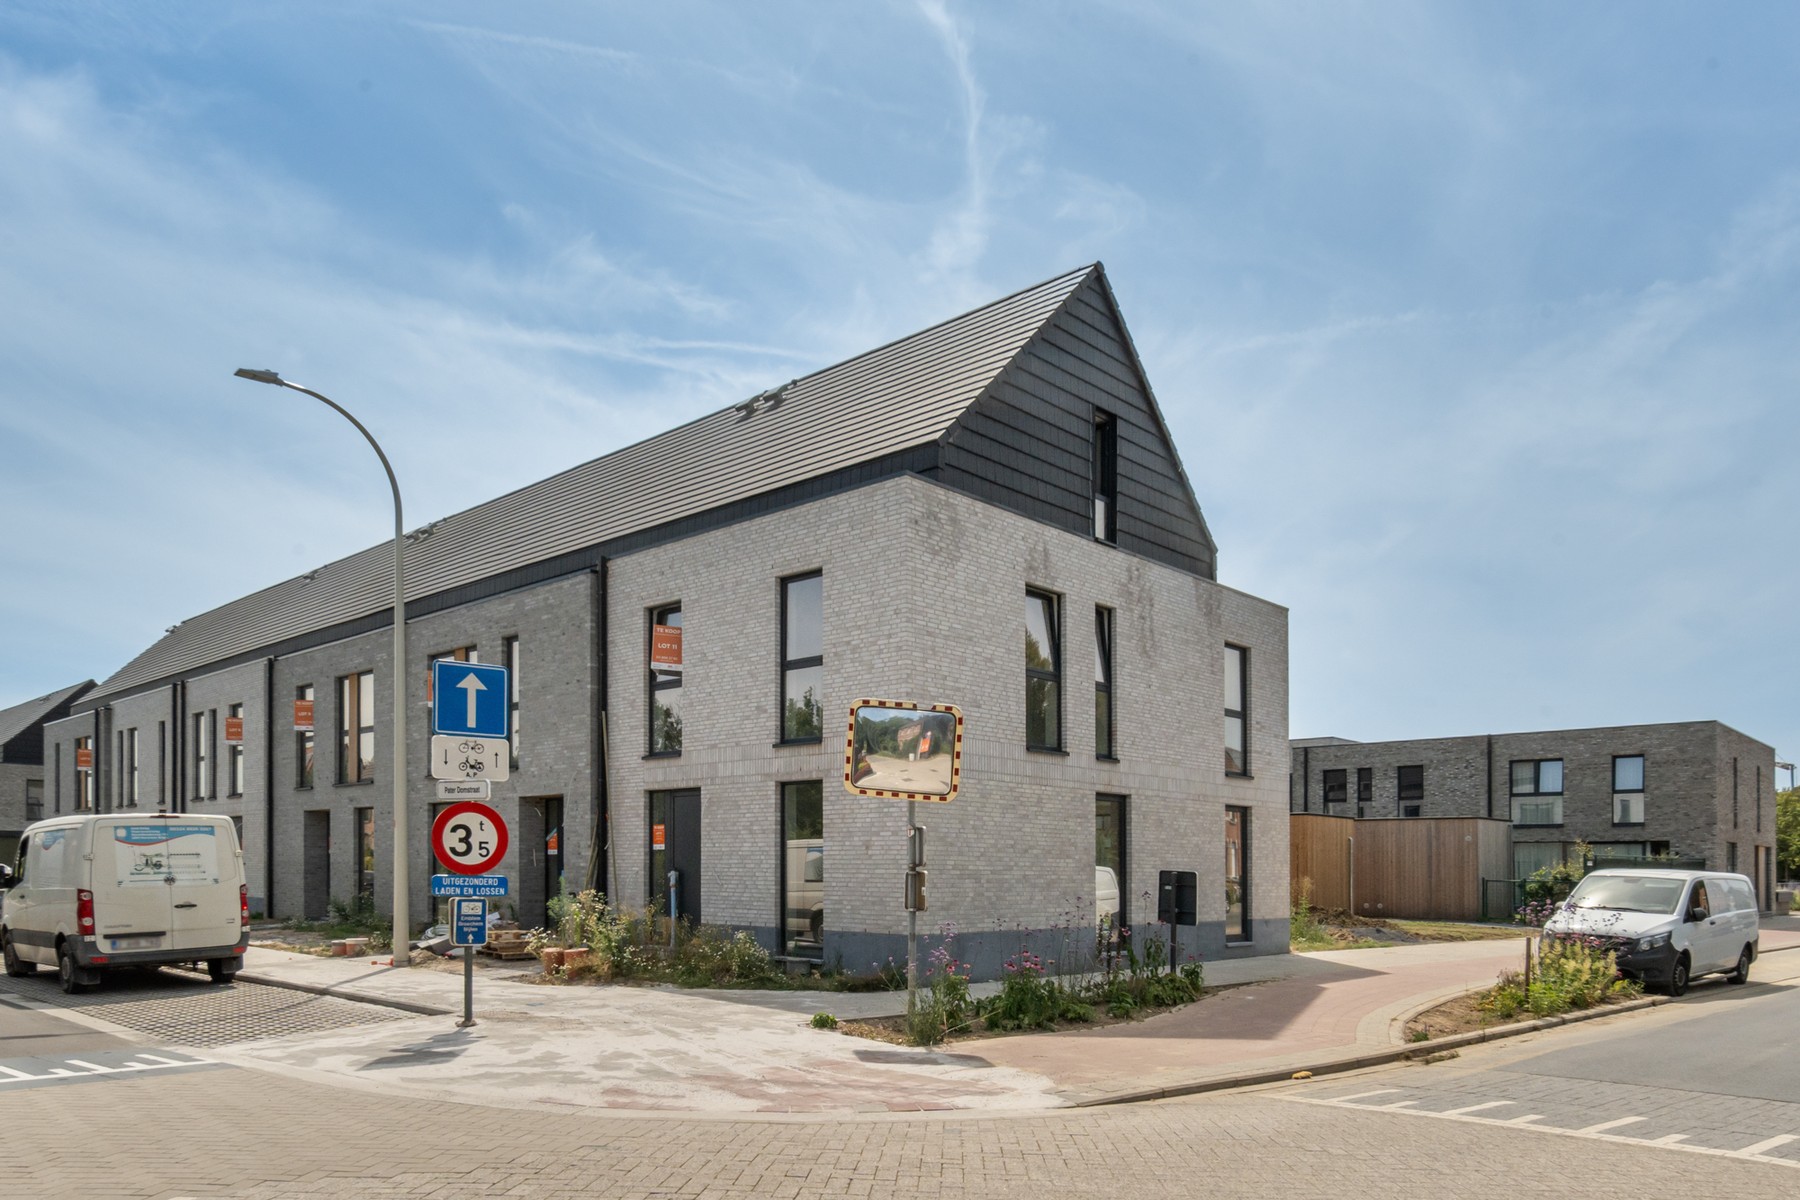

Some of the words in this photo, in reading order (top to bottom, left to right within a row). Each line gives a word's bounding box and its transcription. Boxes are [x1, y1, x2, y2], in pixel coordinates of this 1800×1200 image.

[479, 820, 485, 832] t
[442, 877, 499, 886] UITGEZONDERD
[435, 887, 461, 895] LADEN
[463, 887, 474, 895] EN
[476, 887, 505, 895] LOSSEN
